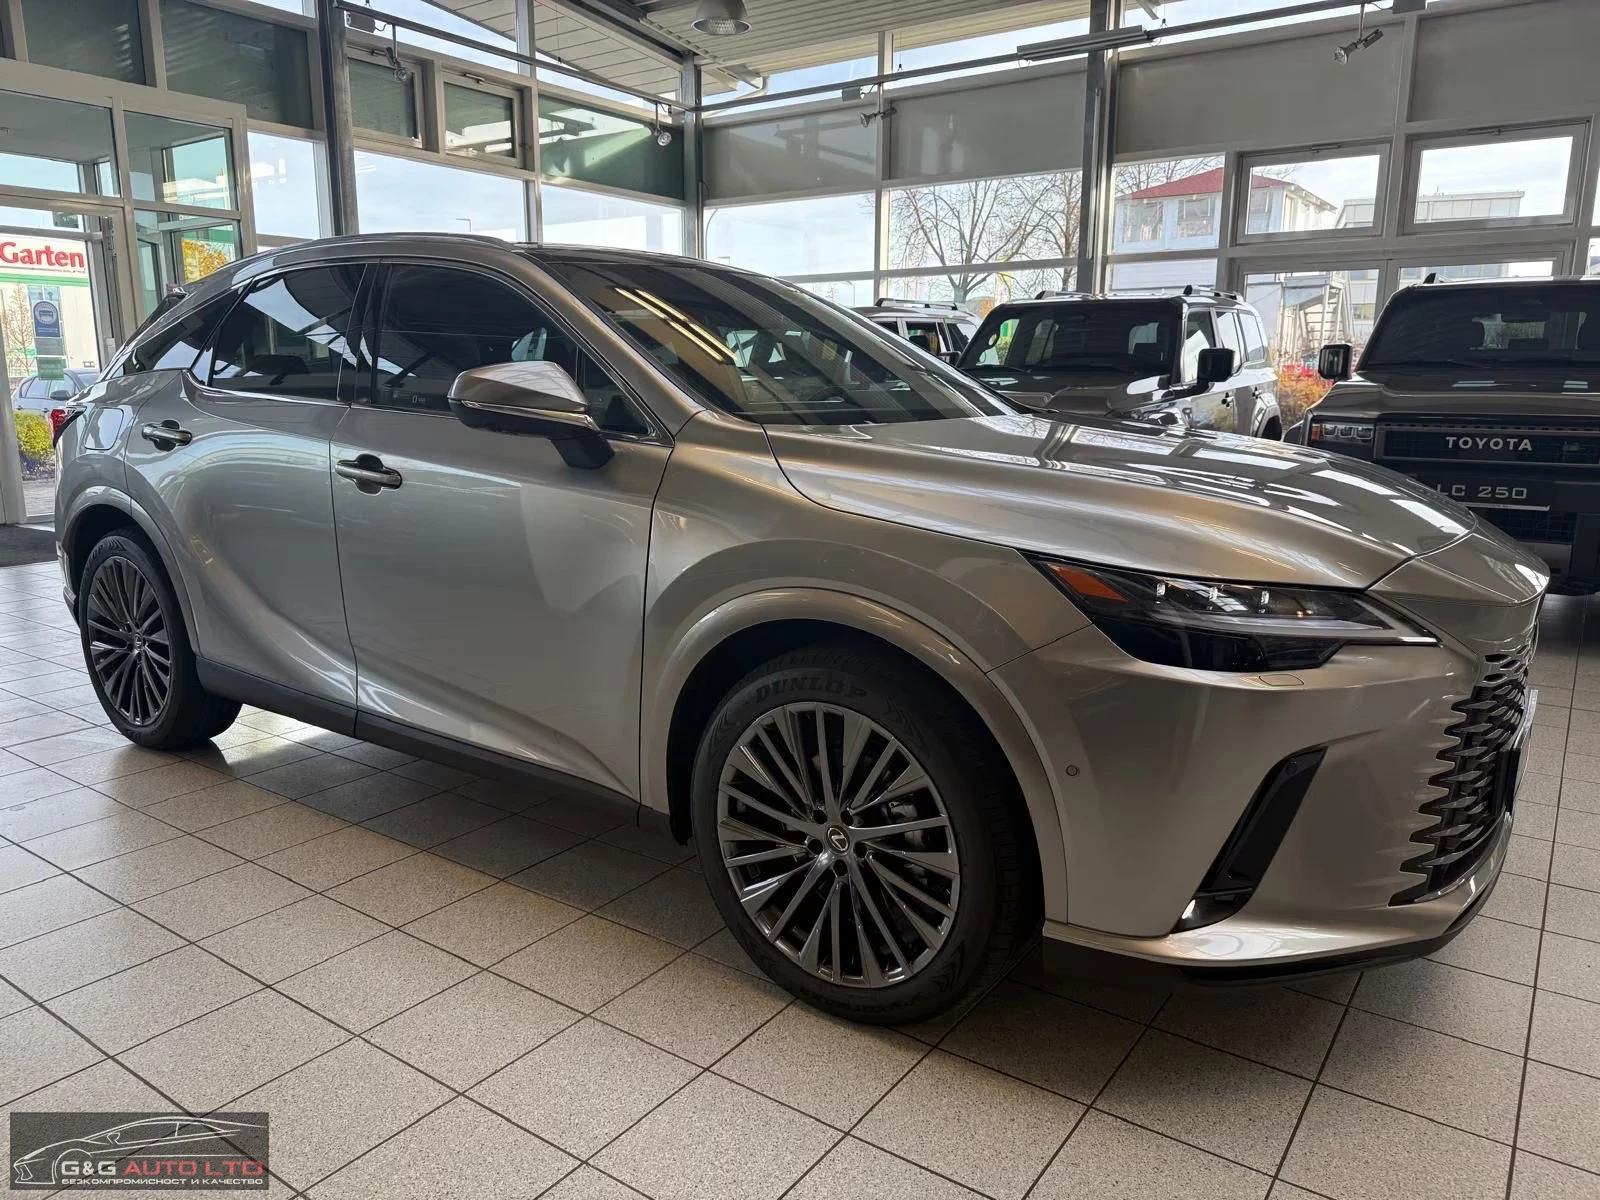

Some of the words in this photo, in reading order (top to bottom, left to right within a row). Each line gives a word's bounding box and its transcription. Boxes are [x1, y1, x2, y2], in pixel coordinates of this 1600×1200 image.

[0, 241, 84, 268] Garten
[1445, 436, 1533, 452] TOYOTA
[1437, 484, 1466, 496] LC
[1477, 486, 1527, 499] 250
[756, 675, 868, 703] DUNLOP
